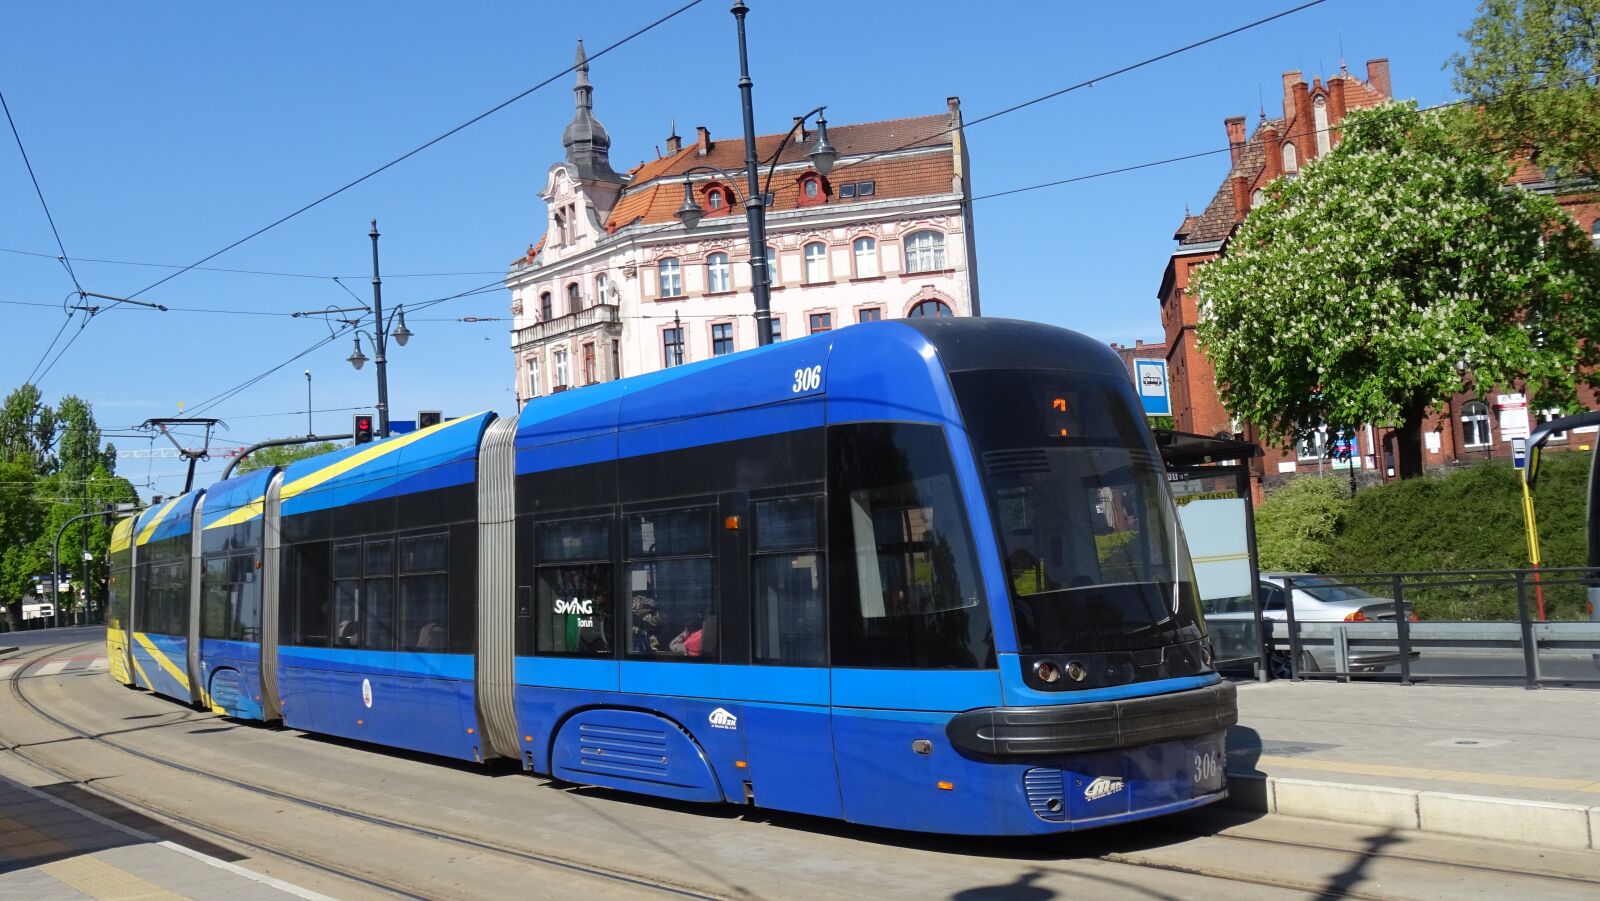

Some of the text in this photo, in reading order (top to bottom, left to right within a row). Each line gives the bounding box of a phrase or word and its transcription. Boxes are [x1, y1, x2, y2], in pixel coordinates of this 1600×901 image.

[793, 365, 822, 393] 306
[577, 617, 594, 628] Toruń
[1194, 751, 1216, 783] 306
